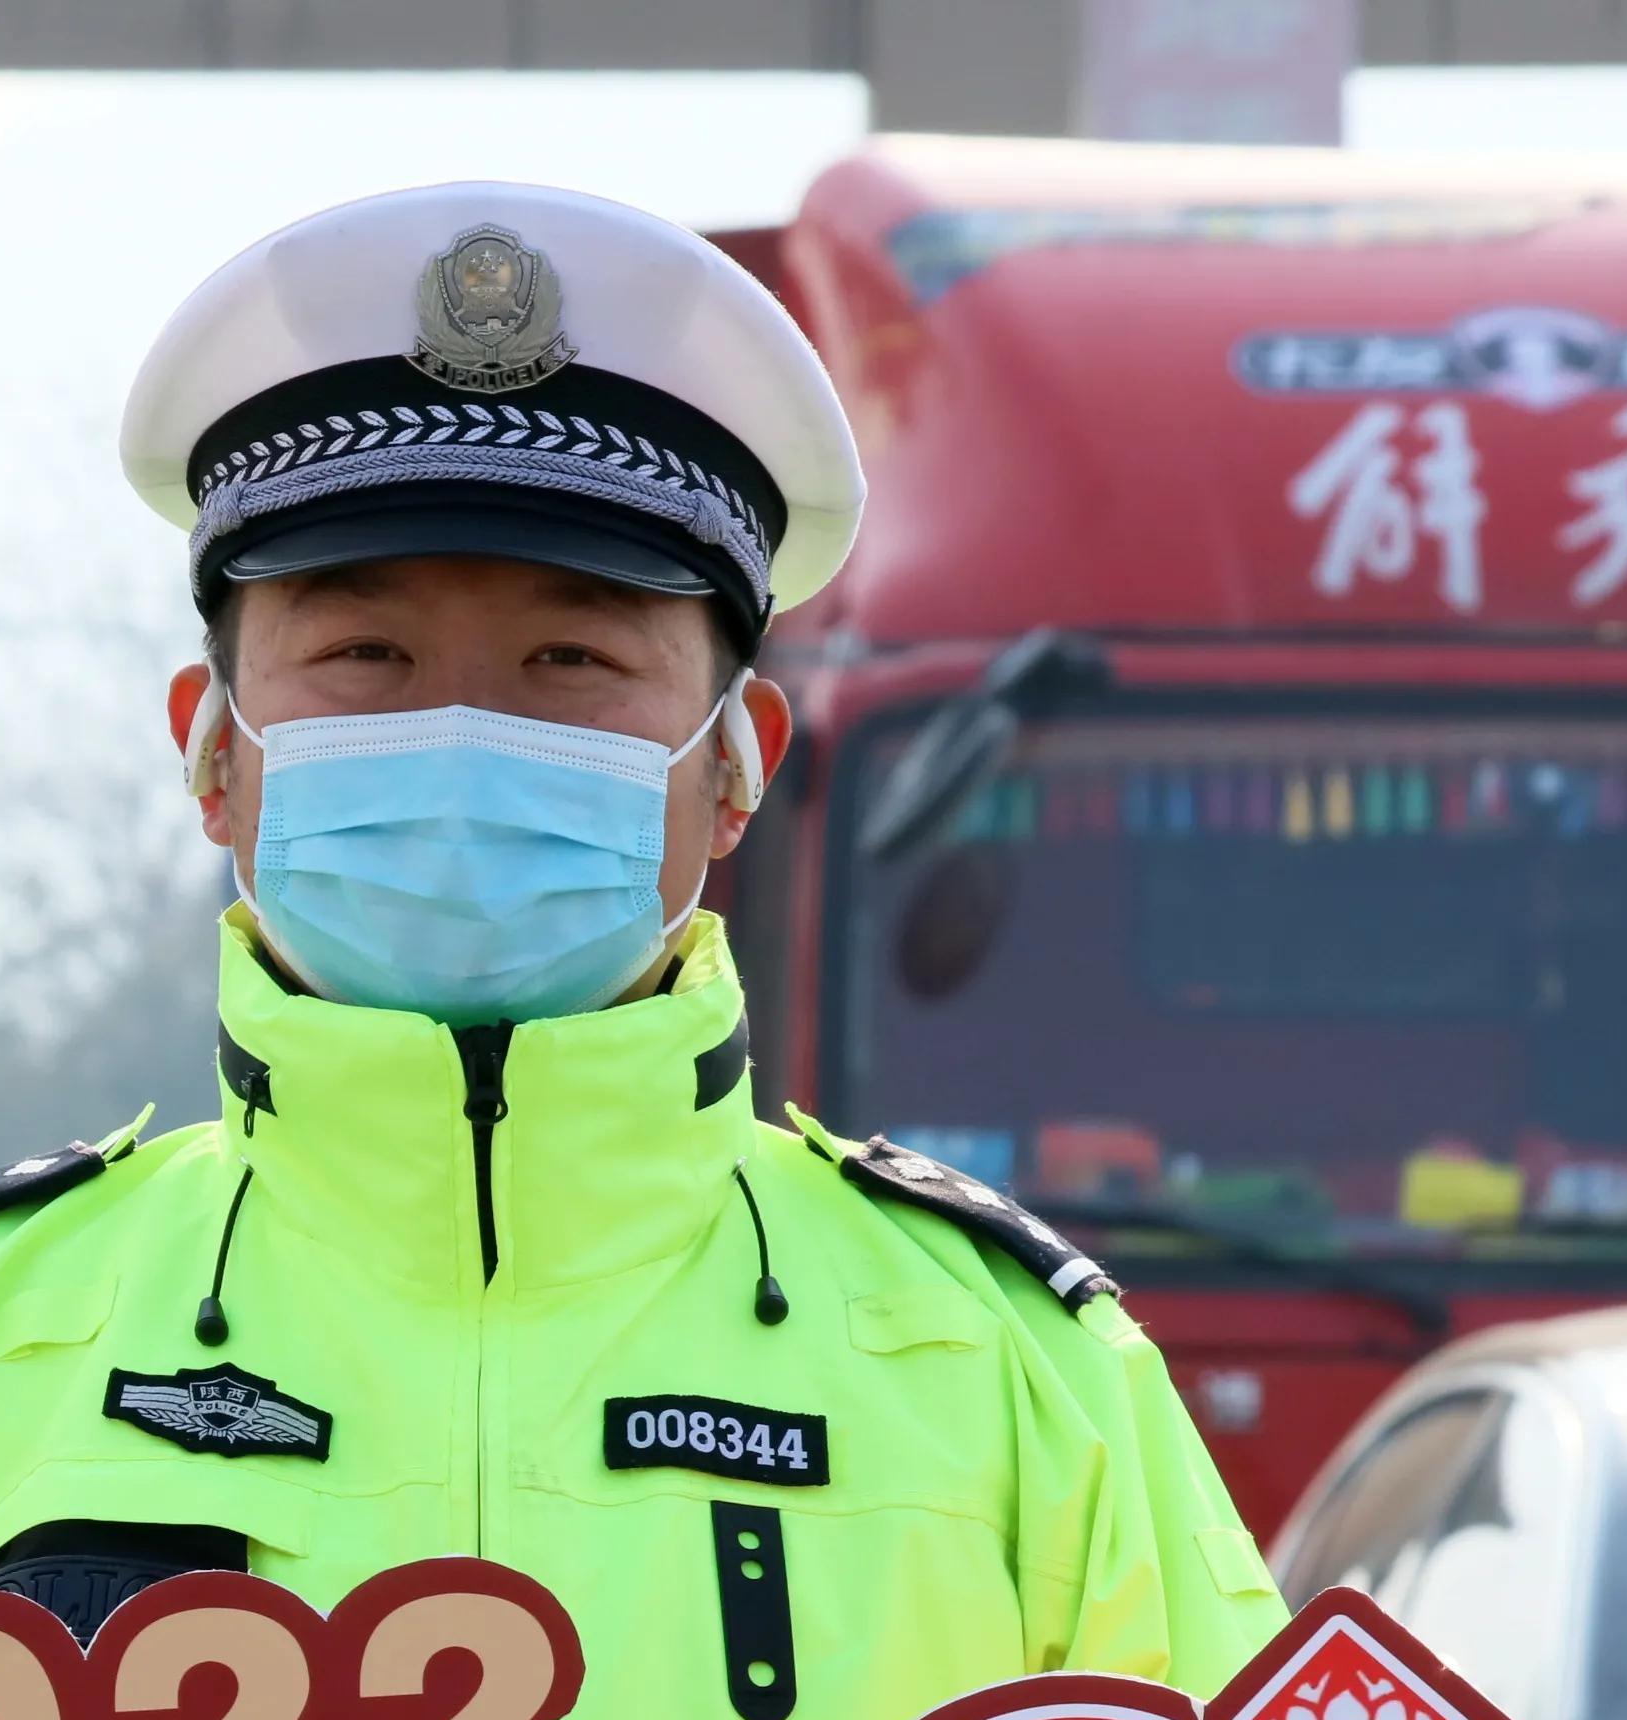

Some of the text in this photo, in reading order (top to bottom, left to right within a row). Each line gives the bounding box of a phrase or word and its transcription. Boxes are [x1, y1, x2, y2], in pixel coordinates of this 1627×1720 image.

[451, 366, 531, 390] POLICE
[199, 1386, 248, 1403] 陕西
[194, 1402, 249, 1416] POLICE
[626, 1408, 809, 1470] 008344
